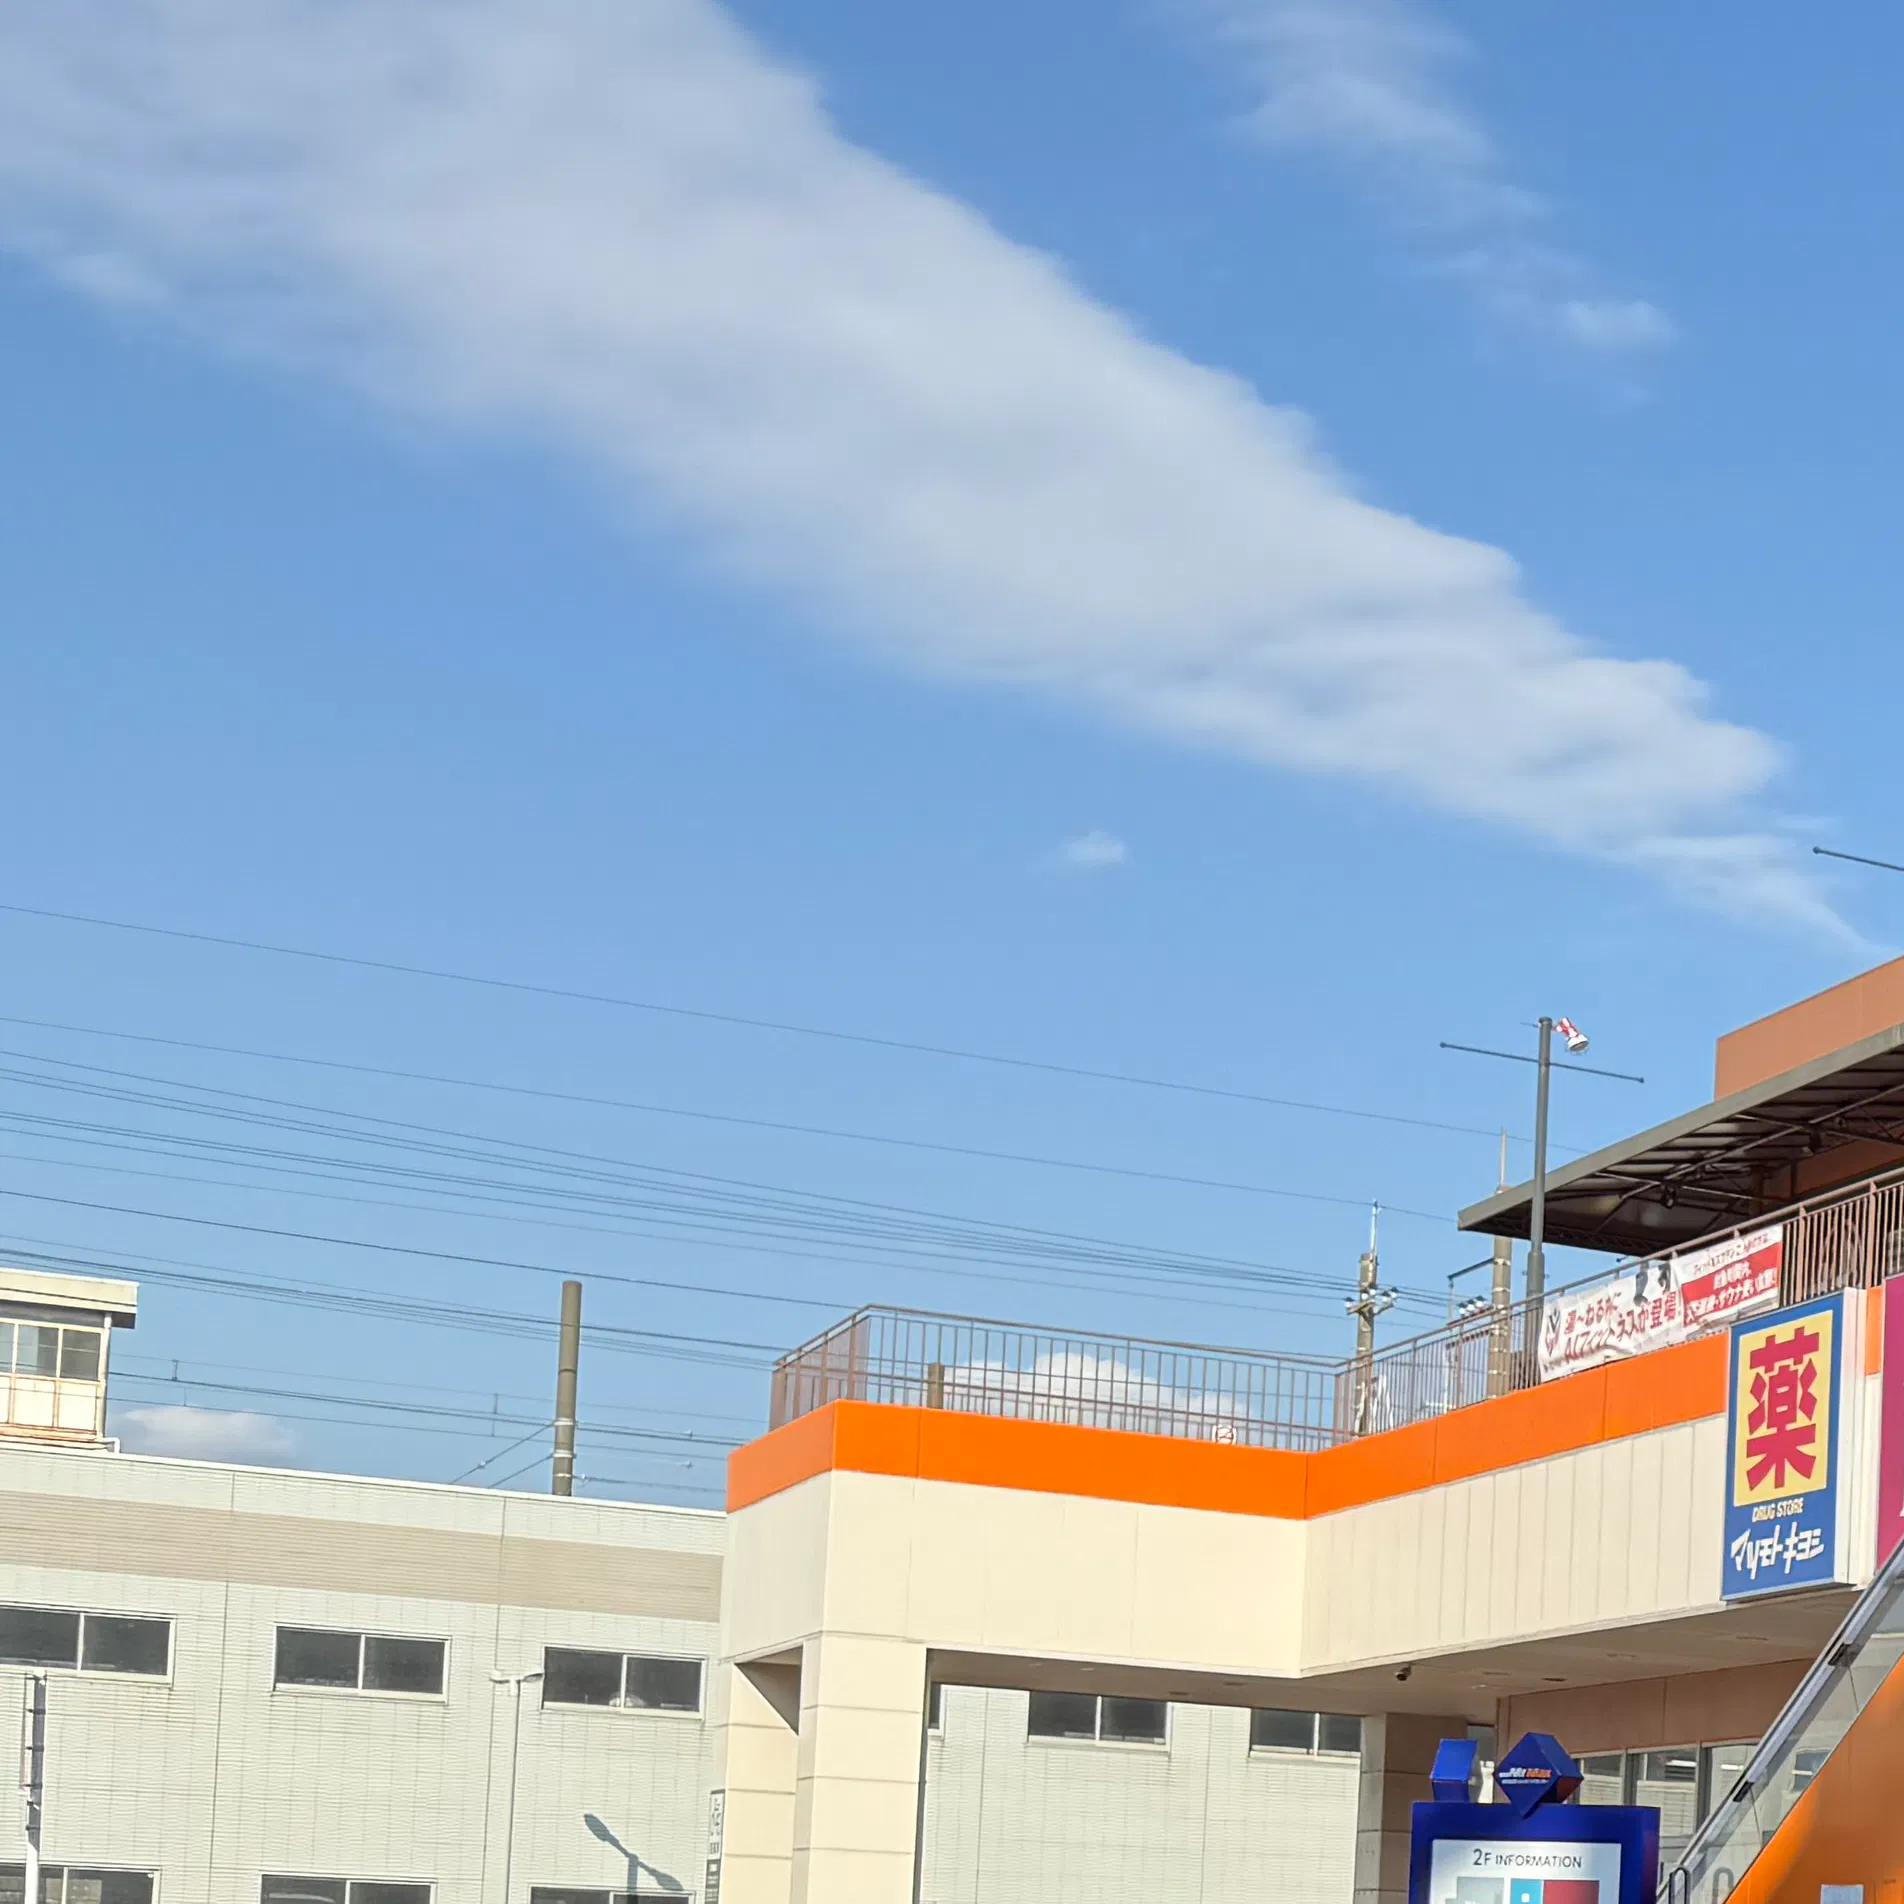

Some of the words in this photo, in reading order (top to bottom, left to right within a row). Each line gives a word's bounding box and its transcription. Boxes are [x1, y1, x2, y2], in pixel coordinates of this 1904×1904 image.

[1746, 1326, 1820, 1491] 薬
[1752, 1504, 1777, 1523] DRUG
[1776, 1498, 1804, 1519] STORE
[1730, 1521, 1825, 1580] マツモトキヨシ
[1472, 1848, 1493, 1868] 2F
[1495, 1853, 1583, 1869] INFORMATION
